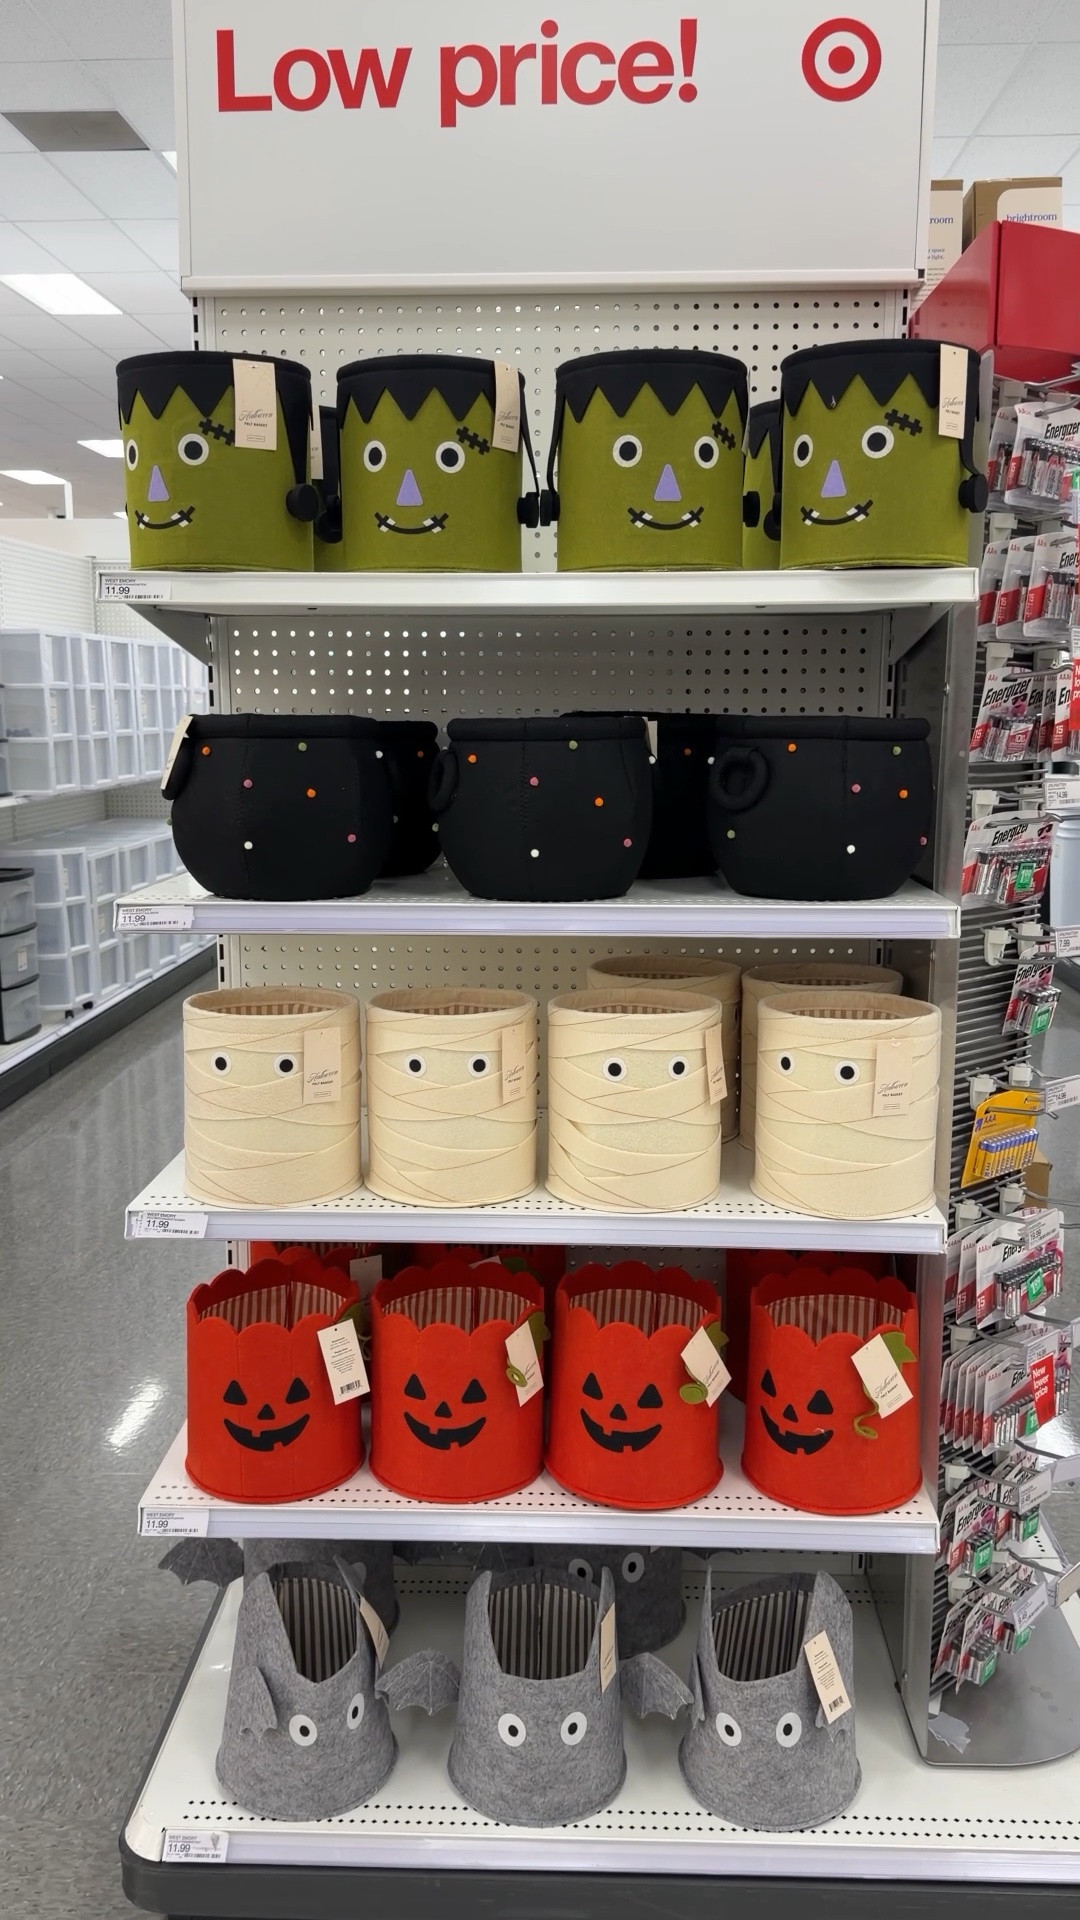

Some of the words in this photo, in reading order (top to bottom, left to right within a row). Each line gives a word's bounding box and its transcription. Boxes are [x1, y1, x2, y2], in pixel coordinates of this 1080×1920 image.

[216, 29, 412, 112] Low
[440, 18, 698, 128] price!
[1044, 421, 1080, 441] Energizer
[105, 586, 130, 595] 11.99
[982, 678, 1032, 707] Energizer
[146, 1219, 169, 1228] 11.99
[1032, 1366, 1046, 1378] New
[1033, 1374, 1049, 1389] lower
[1034, 1386, 1048, 1402] price
[146, 1520, 168, 1528] 11.99
[168, 1843, 191, 1852] 11.99
